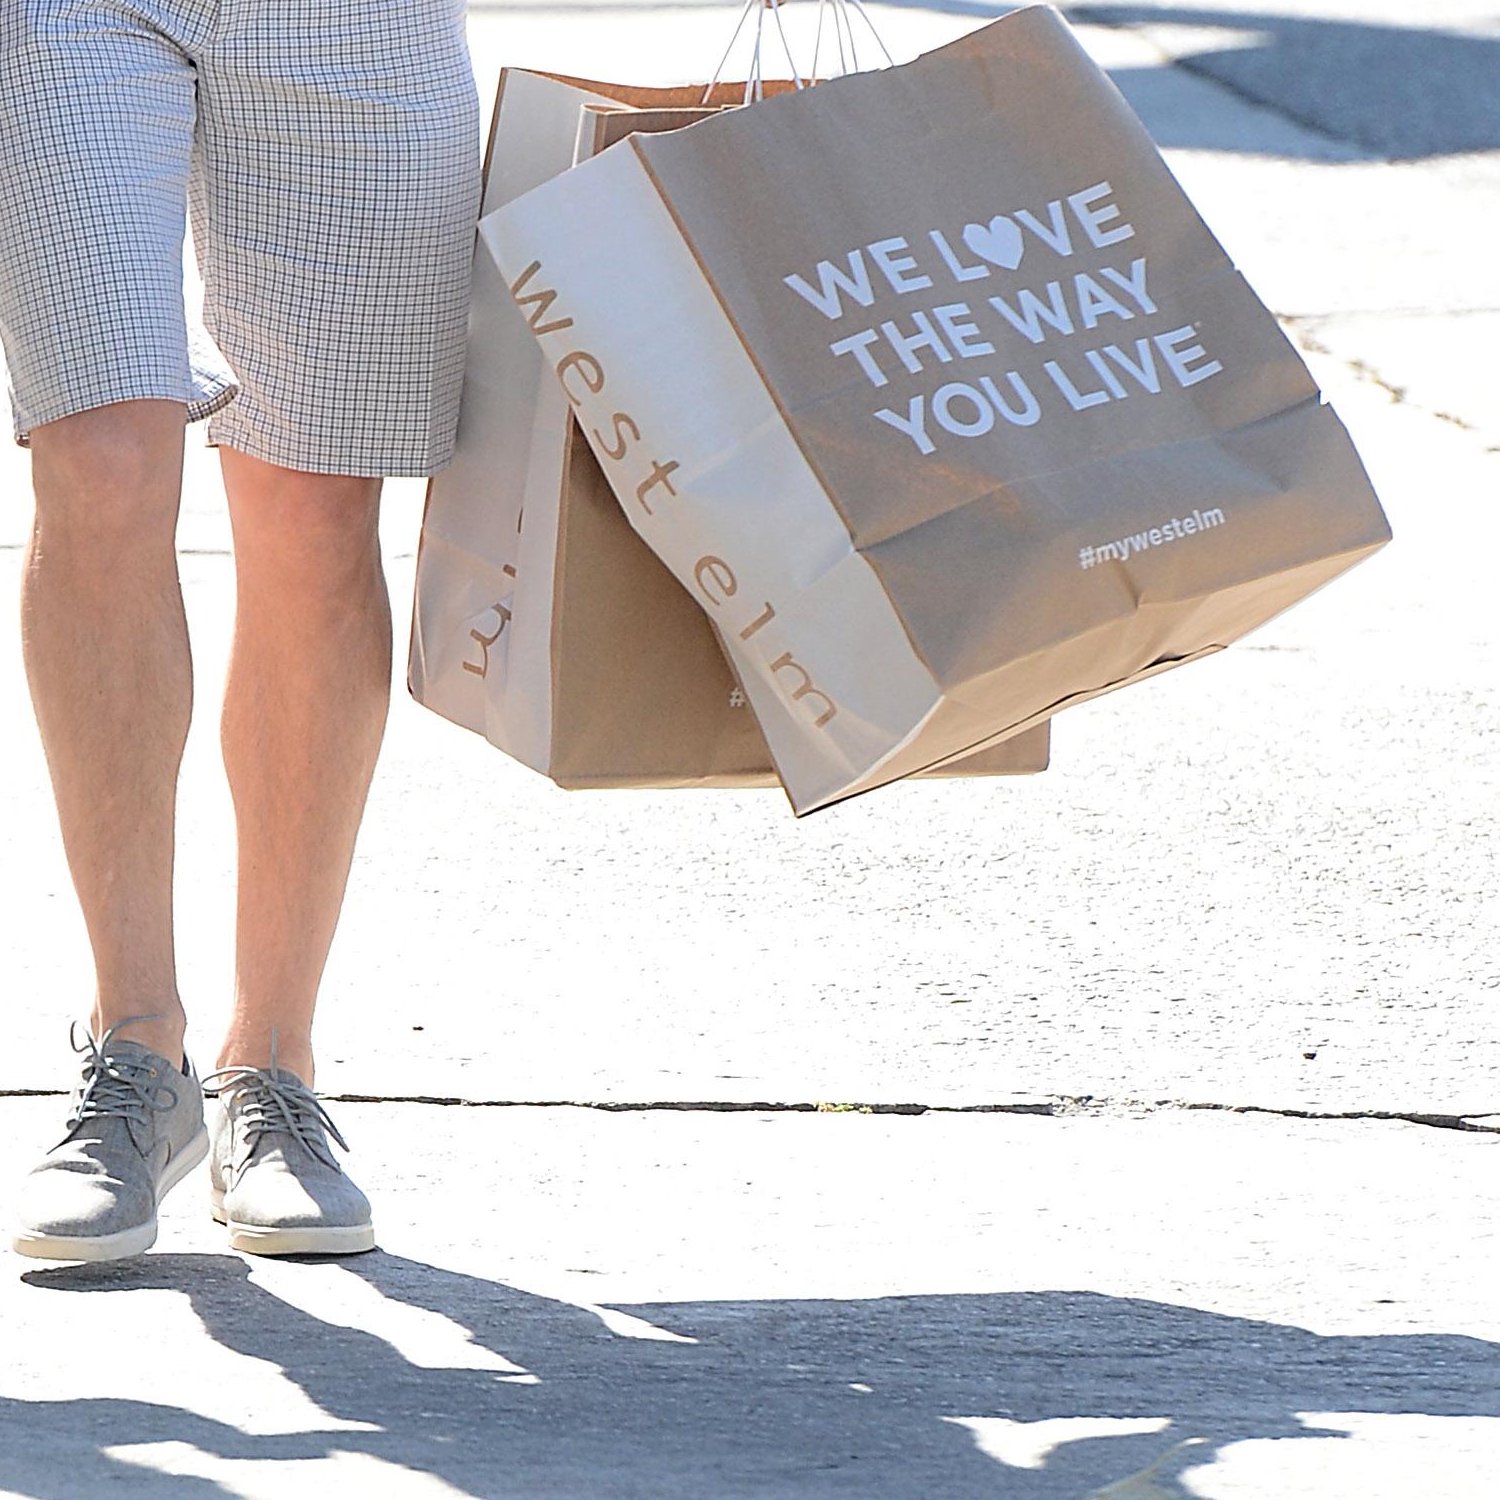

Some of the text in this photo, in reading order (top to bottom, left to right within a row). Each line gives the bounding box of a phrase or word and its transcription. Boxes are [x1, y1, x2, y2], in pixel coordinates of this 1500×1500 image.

[783, 236, 934, 320] WE
[829, 257, 1158, 388] THE WAY
[873, 324, 1223, 456] YOU LIVE
[510, 259, 838, 729] west elm
[1078, 507, 1226, 570] #mywestelm
